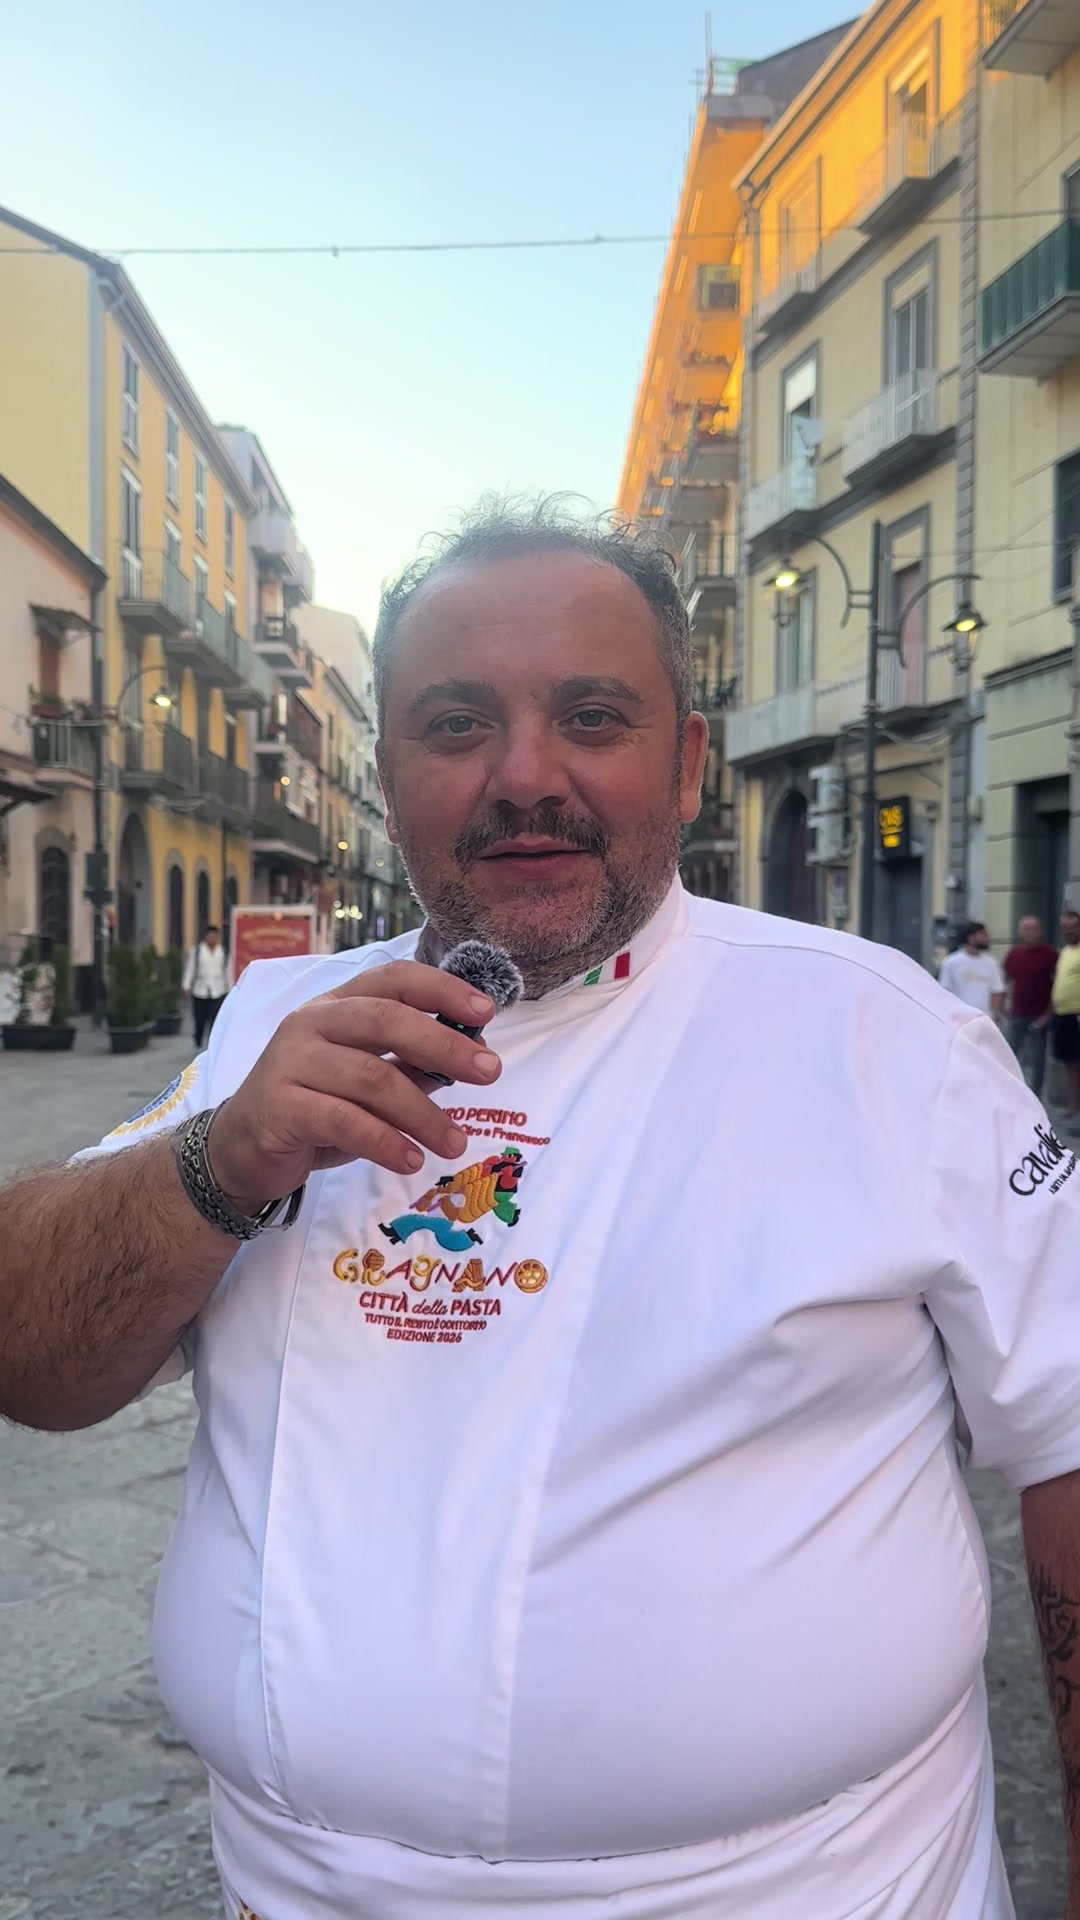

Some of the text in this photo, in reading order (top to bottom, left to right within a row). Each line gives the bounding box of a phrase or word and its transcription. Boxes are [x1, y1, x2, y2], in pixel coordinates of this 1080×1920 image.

[466, 1107, 528, 1127] PERINO
[483, 1128, 491, 1137] e
[492, 1127, 551, 1146] Francesco
[359, 1291, 502, 1316] CITTÀ della PASTA
[364, 1312, 394, 1326] TUTTO
[394, 1316, 404, 1328] IL
[386, 1328, 463, 1344] EDIZIONE 2026
